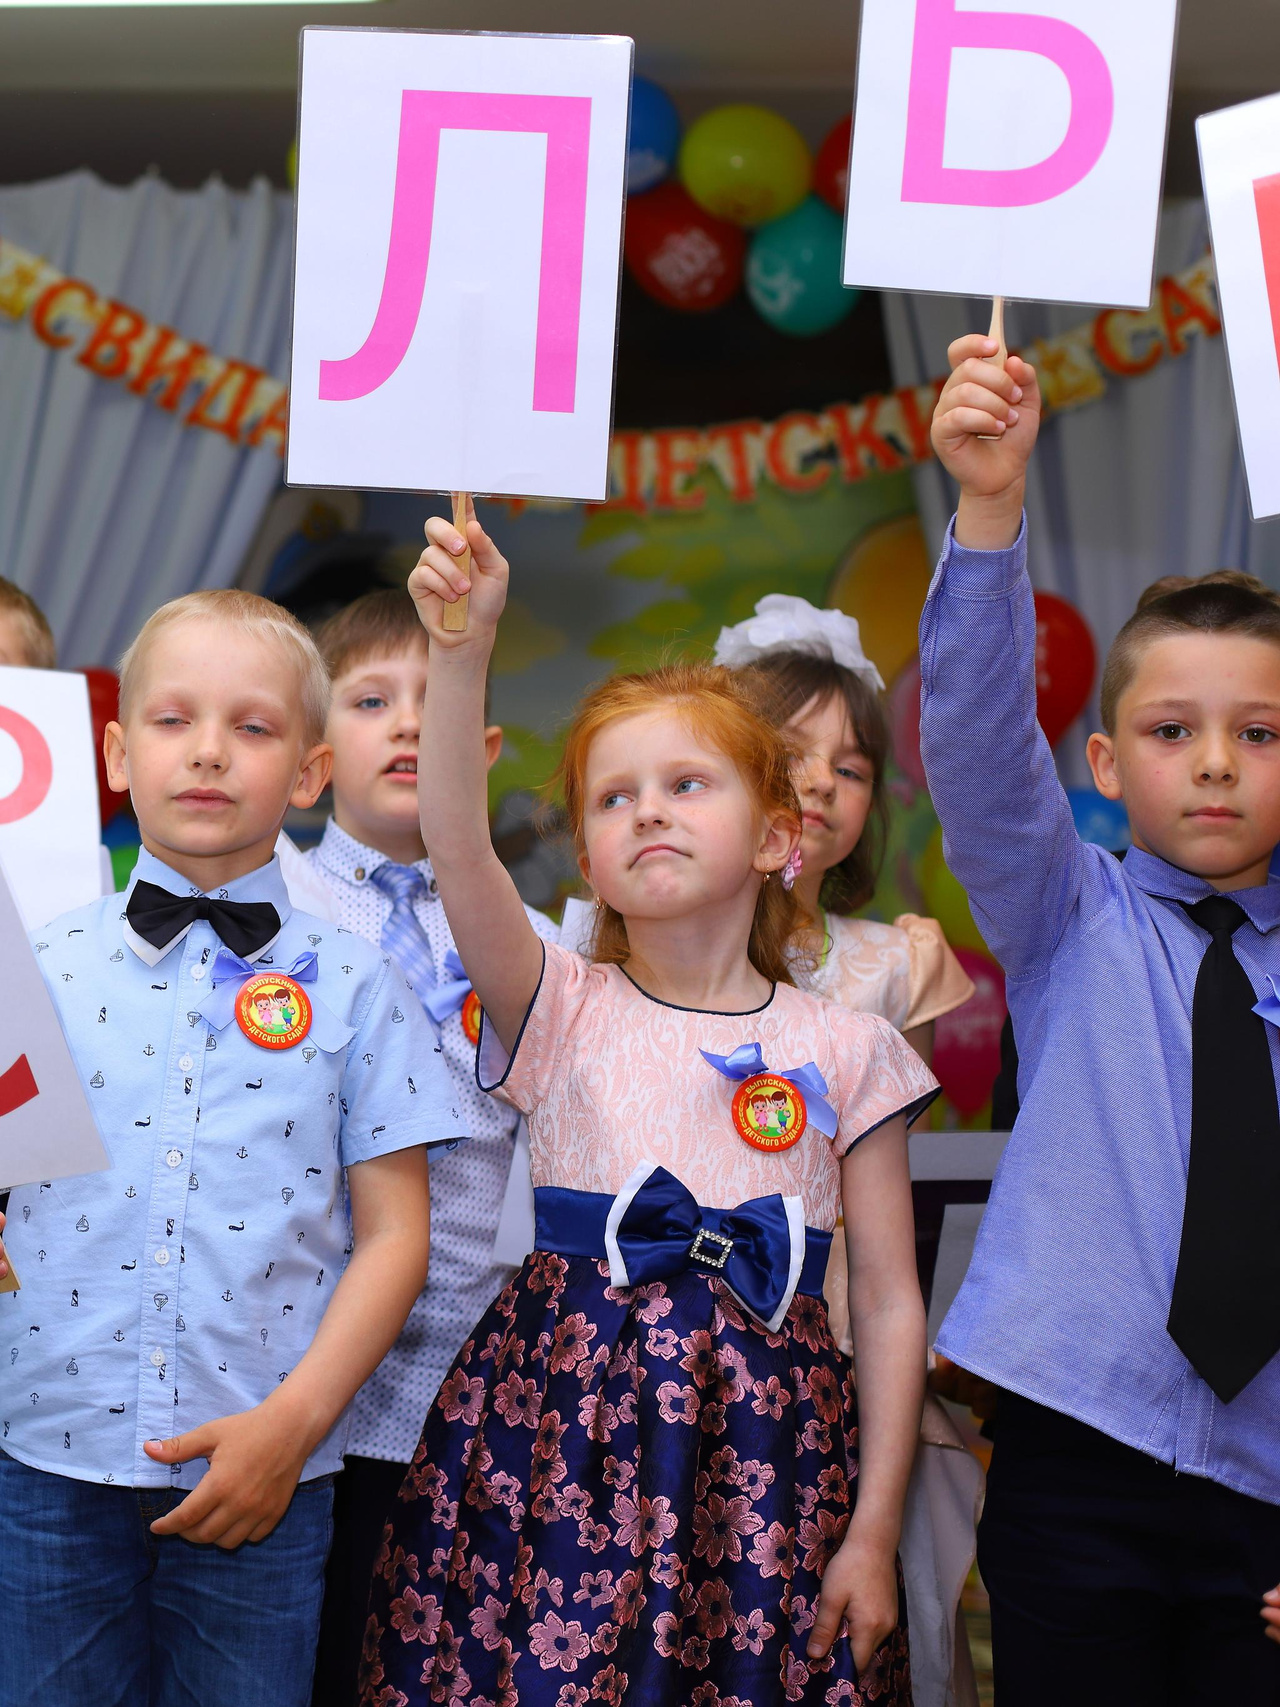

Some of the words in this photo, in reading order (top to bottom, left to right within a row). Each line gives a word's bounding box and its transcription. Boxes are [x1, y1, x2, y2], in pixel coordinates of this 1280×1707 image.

[318, 89, 592, 414] Л
[31, 278, 288, 459] СВИДА
[586, 376, 948, 519] ДЕТСКИ
[1092, 275, 1223, 377] СА
[247, 977, 298, 994] ВЫПУСКНИК
[249, 1025, 286, 1043] ДЕТСКОГО
[287, 1025, 304, 1041] САДА
[745, 1078, 795, 1096] ВЫПУСКНИК
[744, 1128, 779, 1146] ДЕТСКОГО
[781, 1129, 798, 1144] САДА
